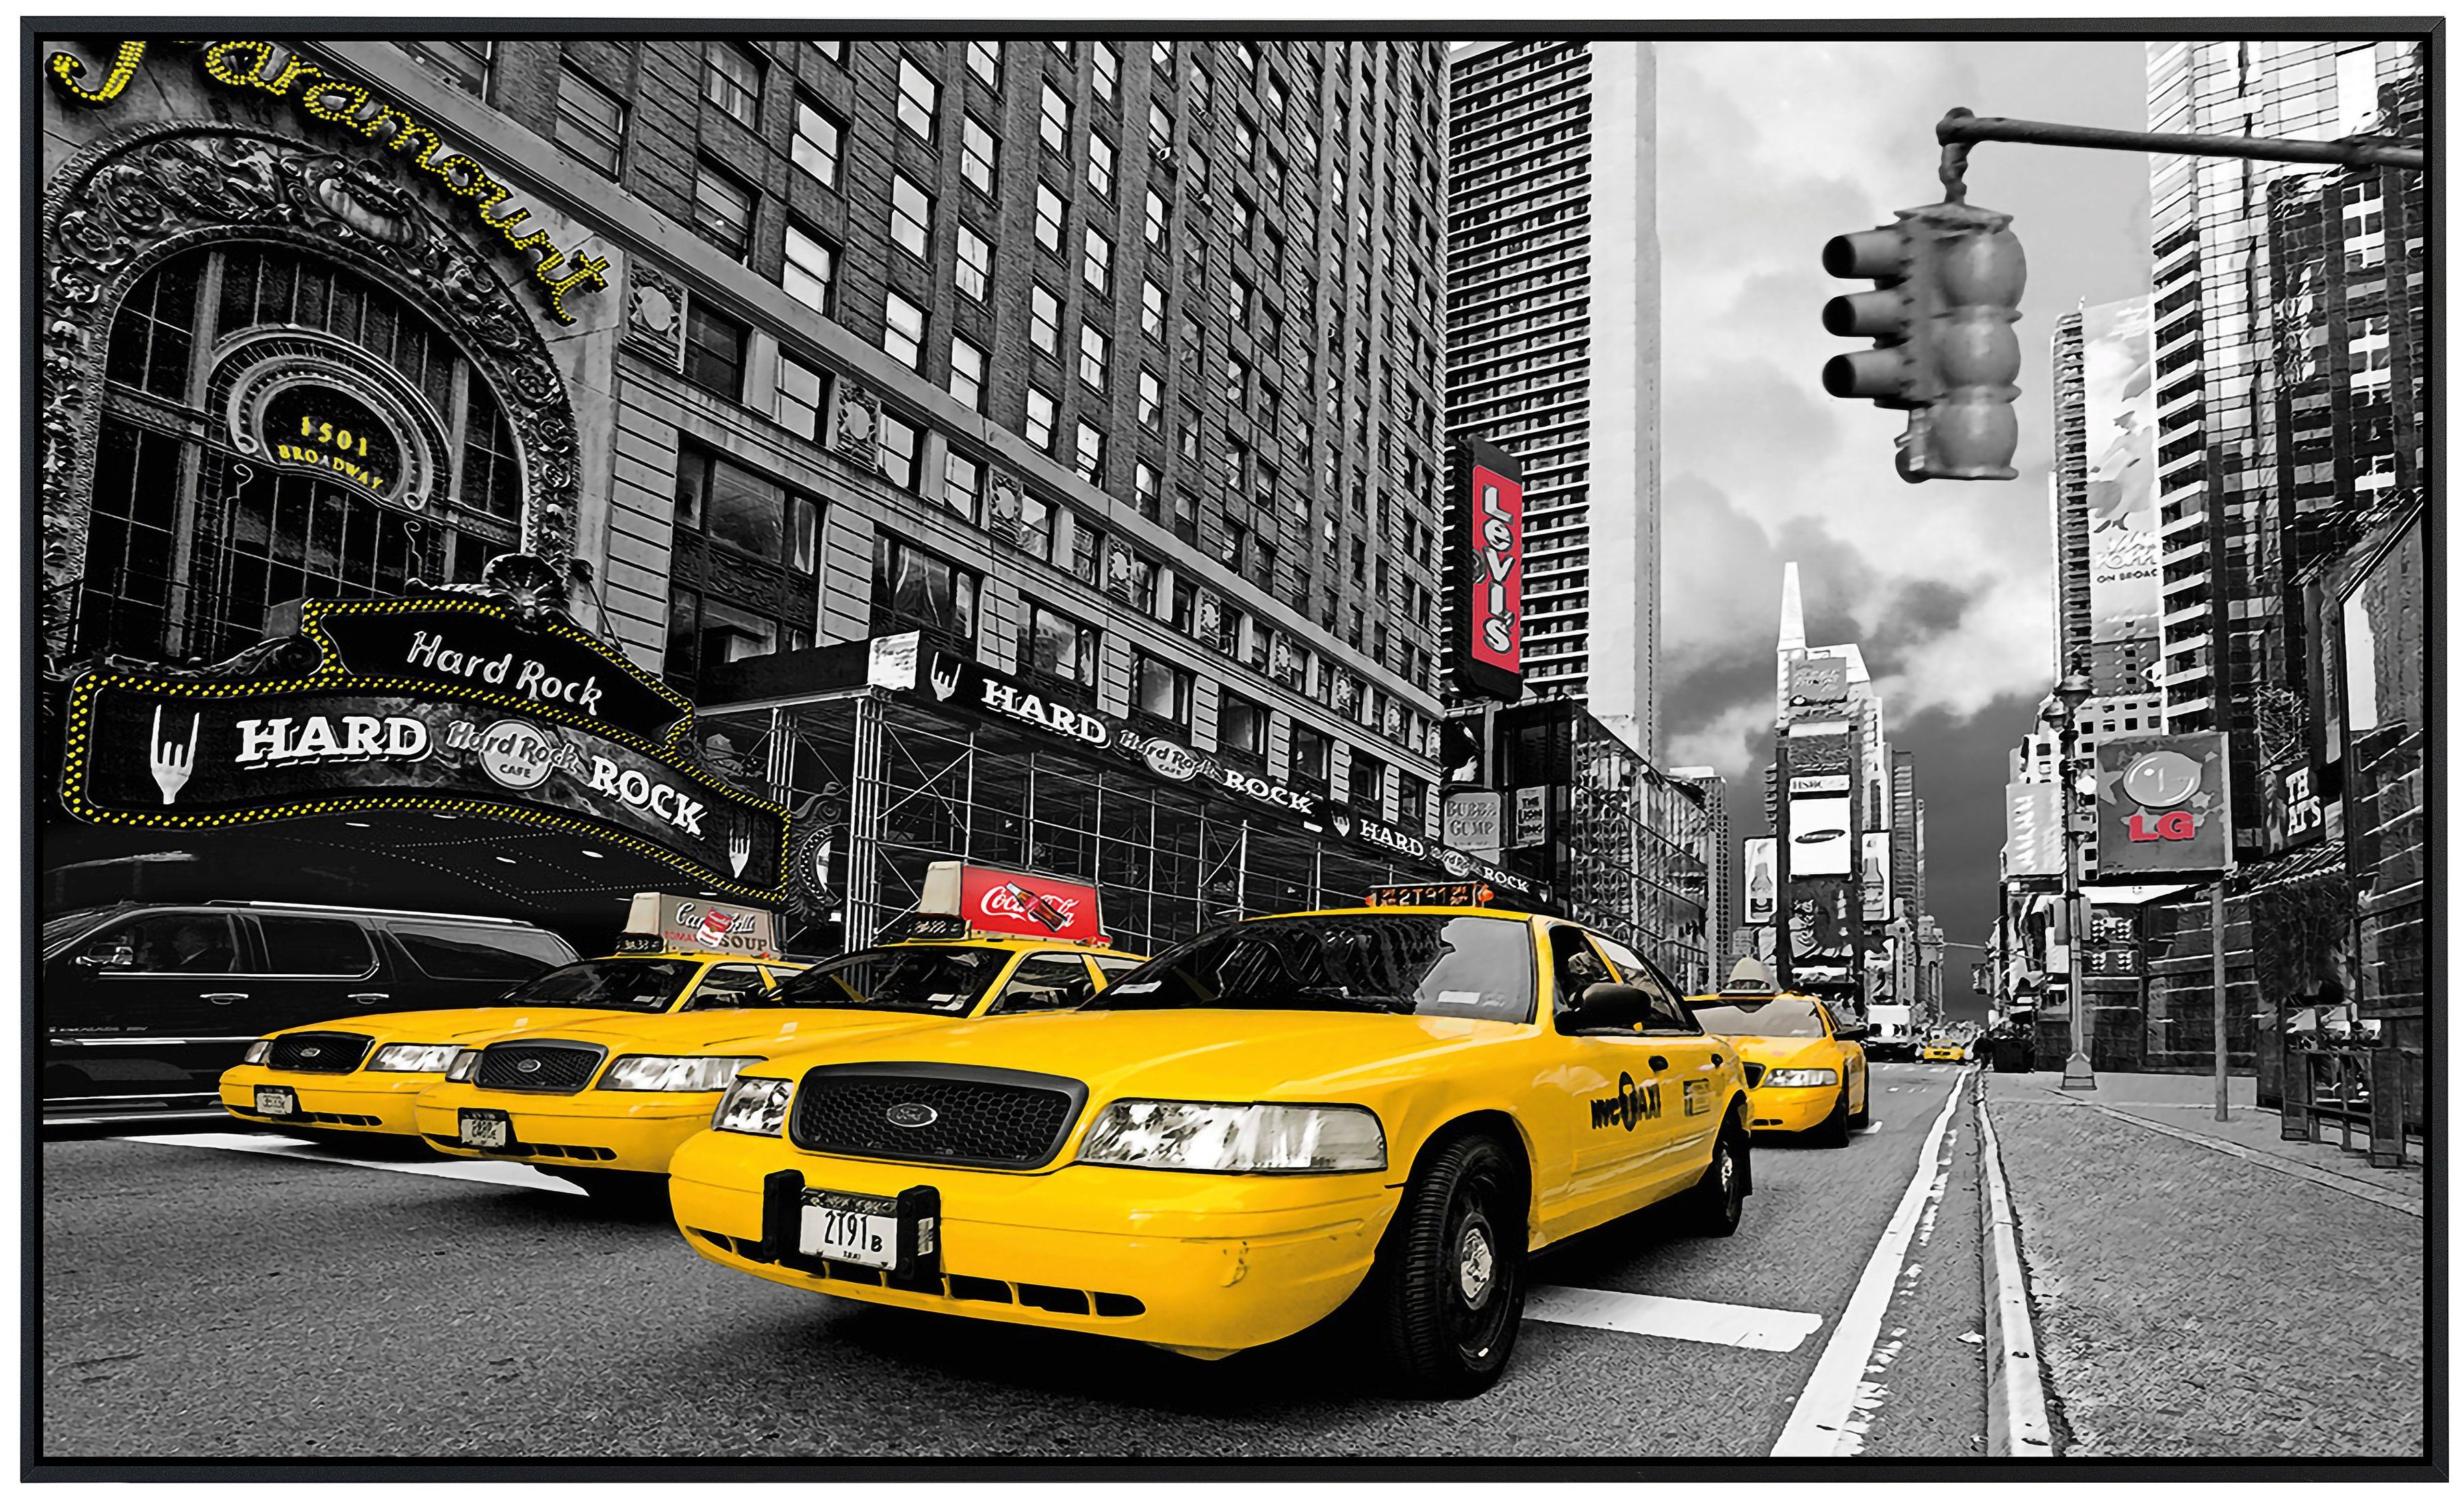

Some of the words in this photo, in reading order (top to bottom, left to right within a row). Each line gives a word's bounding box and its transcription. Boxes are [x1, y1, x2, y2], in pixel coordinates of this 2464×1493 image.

[300, 416, 368, 457] 1501
[277, 445, 384, 489] BROADWAY
[2096, 575, 2116, 583] ON
[407, 630, 512, 684] Hard
[515, 660, 602, 715] Rock
[981, 678, 1108, 744] HARD
[235, 716, 430, 764] HARD
[446, 719, 517, 756] Hard
[518, 736, 578, 774] Rock
[499, 763, 530, 779] CAFE
[1224, 768, 1314, 815] ROCK
[587, 755, 705, 836] ROCK
[1360, 818, 1424, 857] HARD
[2129, 811, 2194, 842] LG
[1483, 866, 1530, 893] ROCK
[664, 931, 697, 942] TOMA
[719, 934, 767, 951] SOUP
